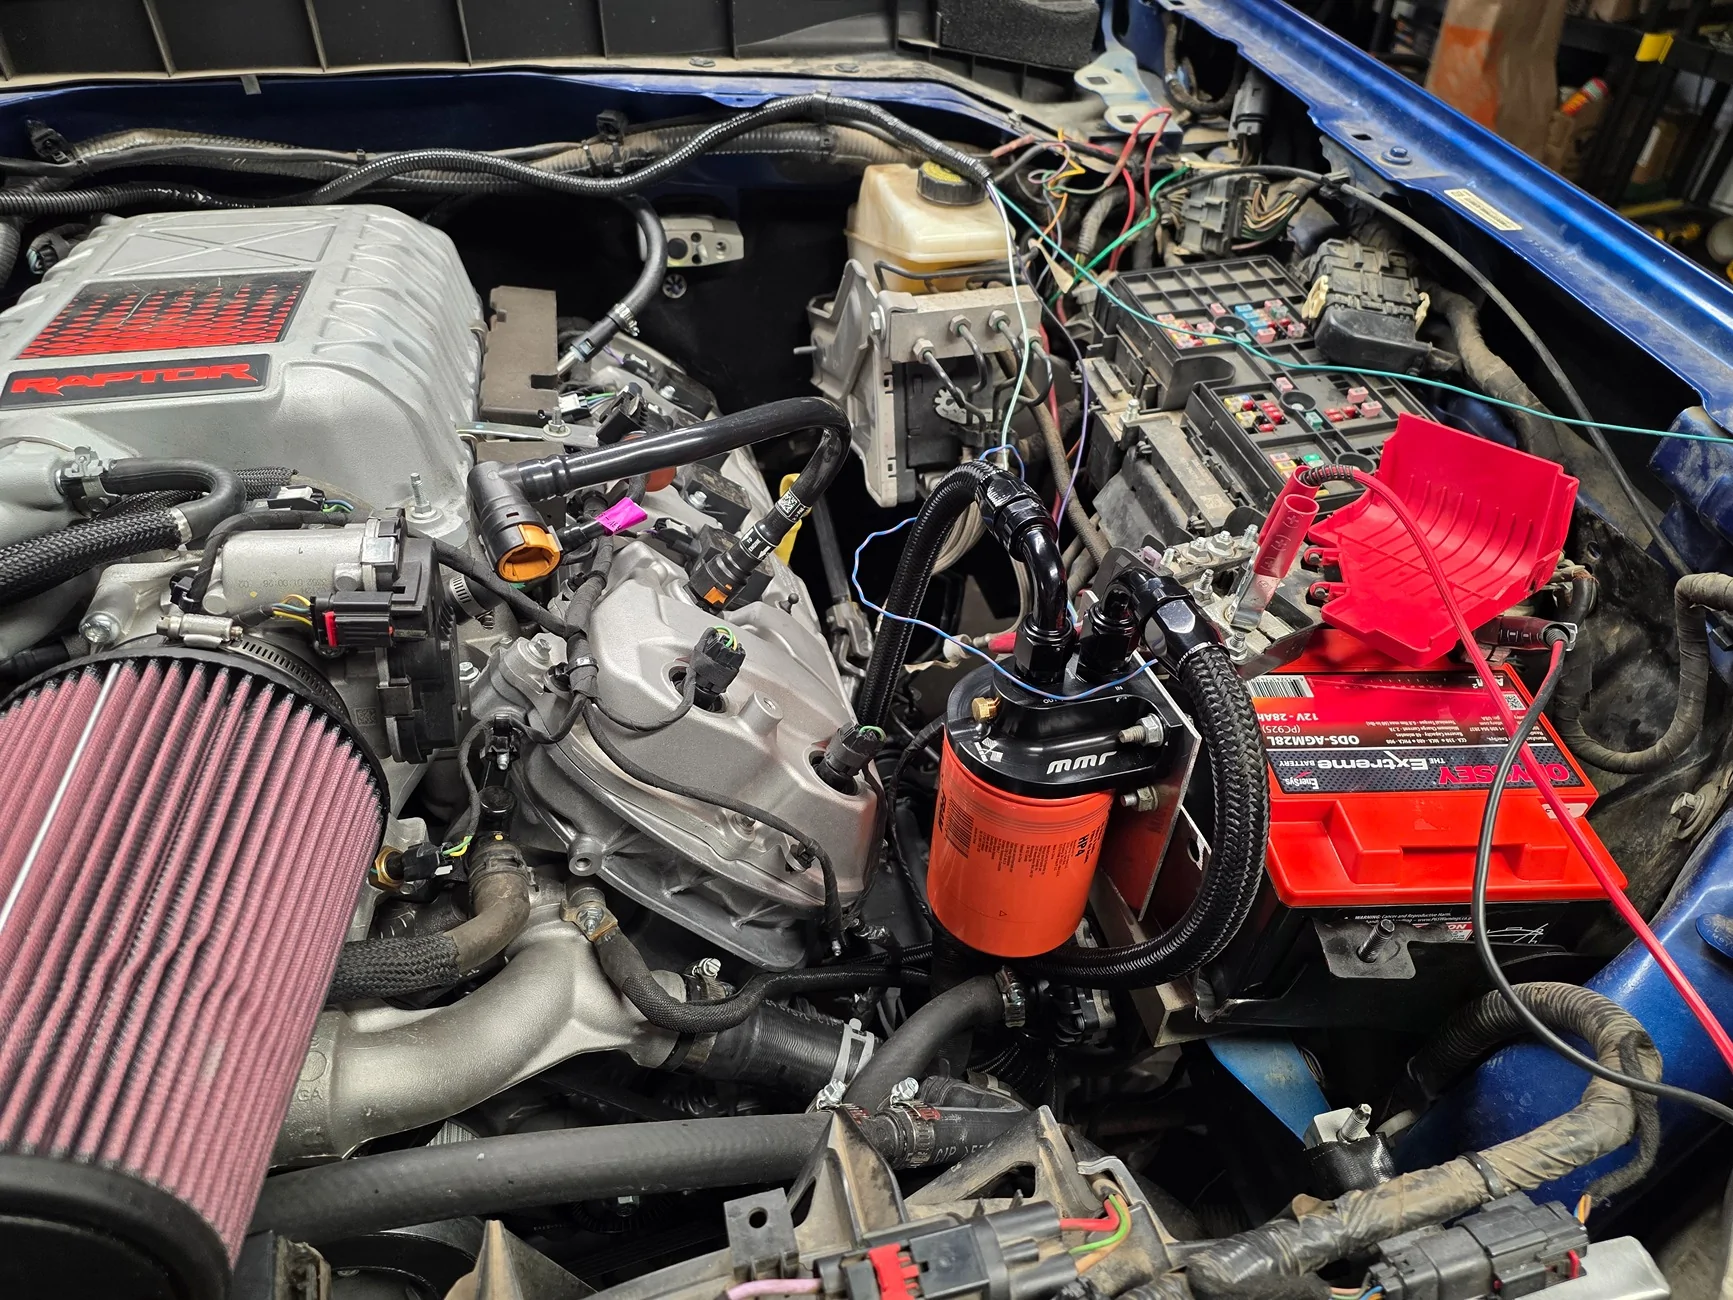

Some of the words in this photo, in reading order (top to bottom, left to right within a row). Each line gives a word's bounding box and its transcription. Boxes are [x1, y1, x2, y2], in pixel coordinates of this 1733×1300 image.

[10, 363, 259, 397] RAPTOR
[1257, 712, 1287, 722] 28Ah
[1296, 712, 1319, 722] 12V
[1262, 725, 1301, 734] (PC925)
[1267, 735, 1360, 746] ODS-AGM28L
[1046, 751, 1117, 774] mmr
[1279, 759, 1316, 767] BATTERY
[1317, 751, 1429, 771] Extreme
[1439, 764, 1570, 785] OYSEY
[1075, 833, 1090, 858] HP4
